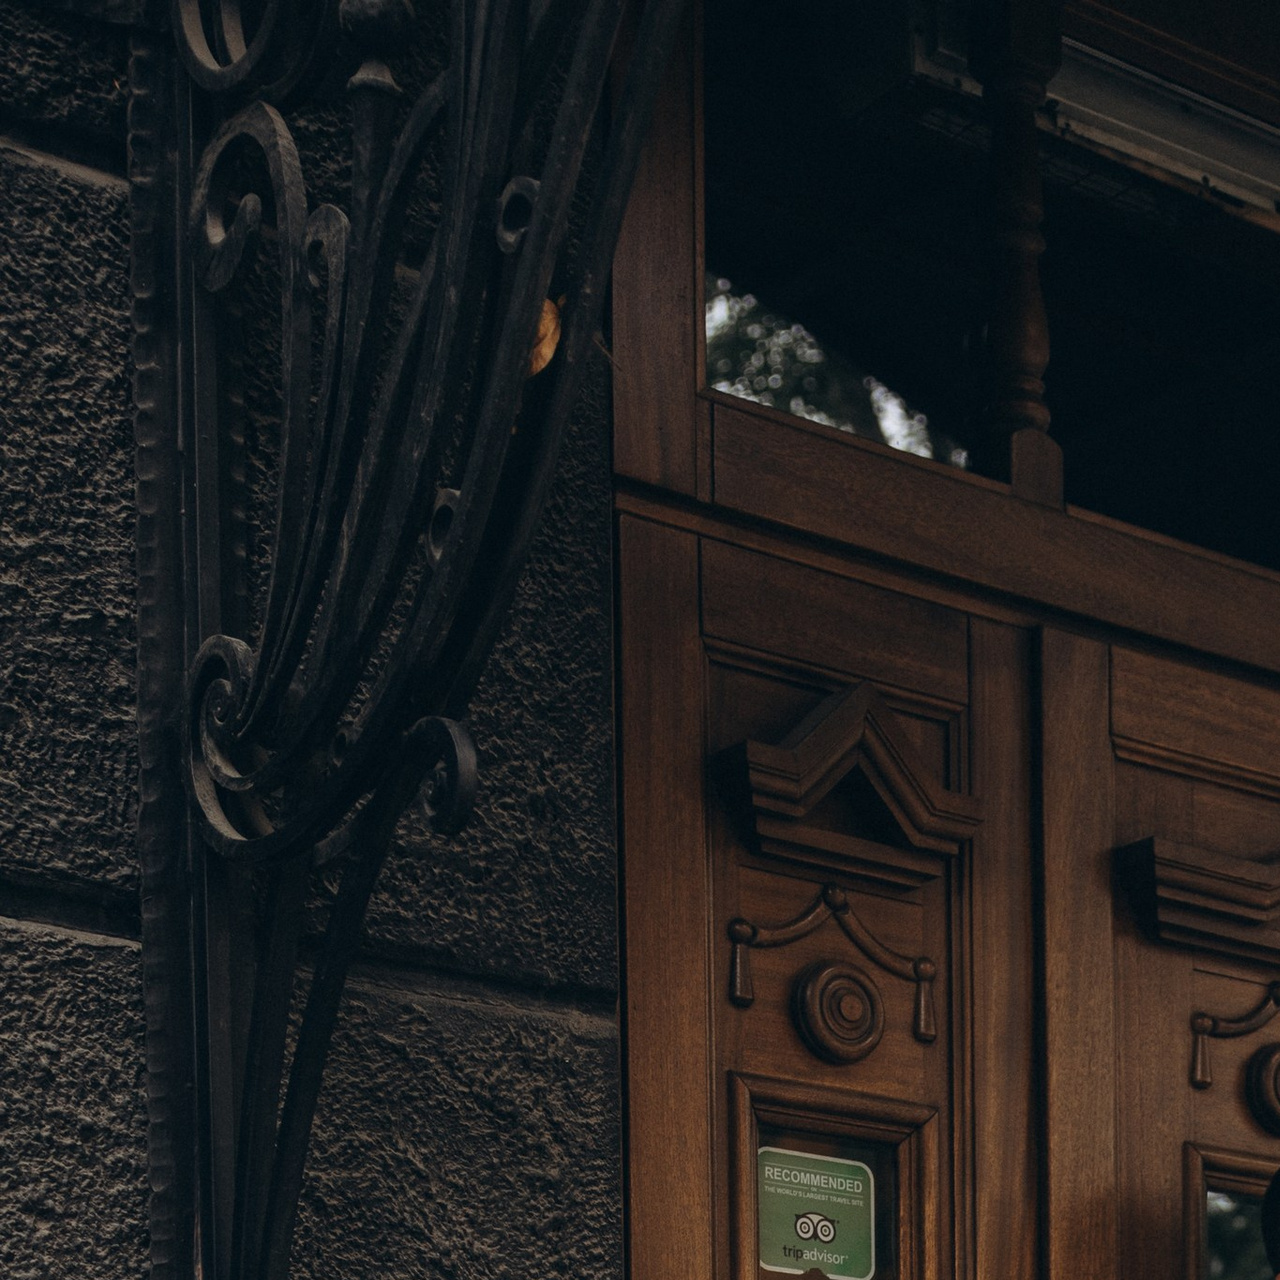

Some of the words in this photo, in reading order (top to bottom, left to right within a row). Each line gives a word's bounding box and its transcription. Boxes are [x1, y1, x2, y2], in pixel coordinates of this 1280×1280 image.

[764, 1166, 863, 1193] RECOMMENDED
[764, 1185, 776, 1194] THE
[802, 1192, 829, 1201] LARGEST
[829, 1196, 851, 1205] TRAVEL
[851, 1199, 864, 1207] SITE
[782, 1244, 845, 1265] tripadvisor
